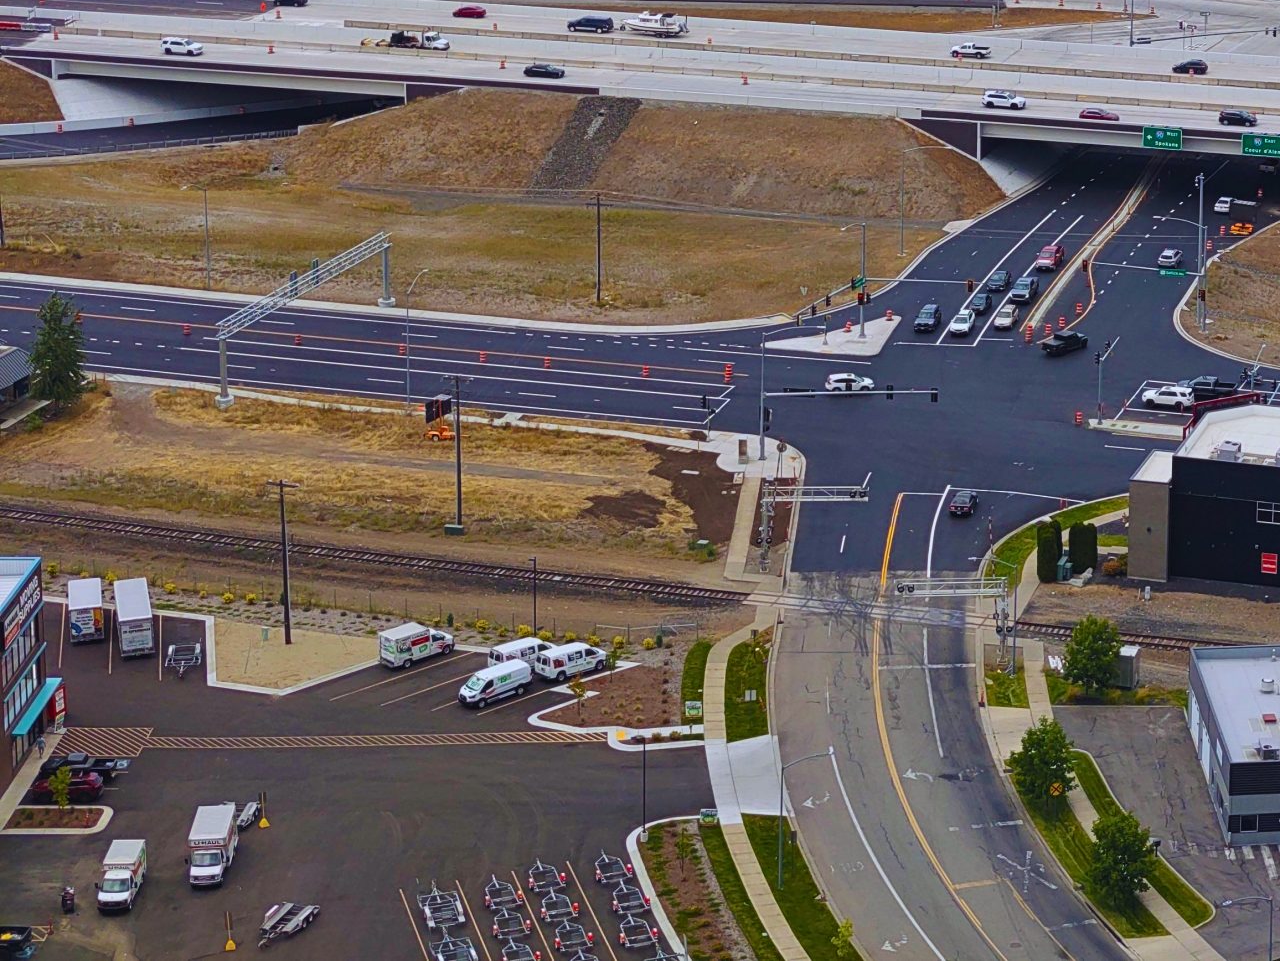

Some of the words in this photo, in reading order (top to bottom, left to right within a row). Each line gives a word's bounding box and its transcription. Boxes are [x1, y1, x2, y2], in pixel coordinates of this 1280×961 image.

[1155, 140, 1178, 148] Spokane
[19, 575, 39, 605] MOVING
[19, 589, 41, 624] SUPPLIES
